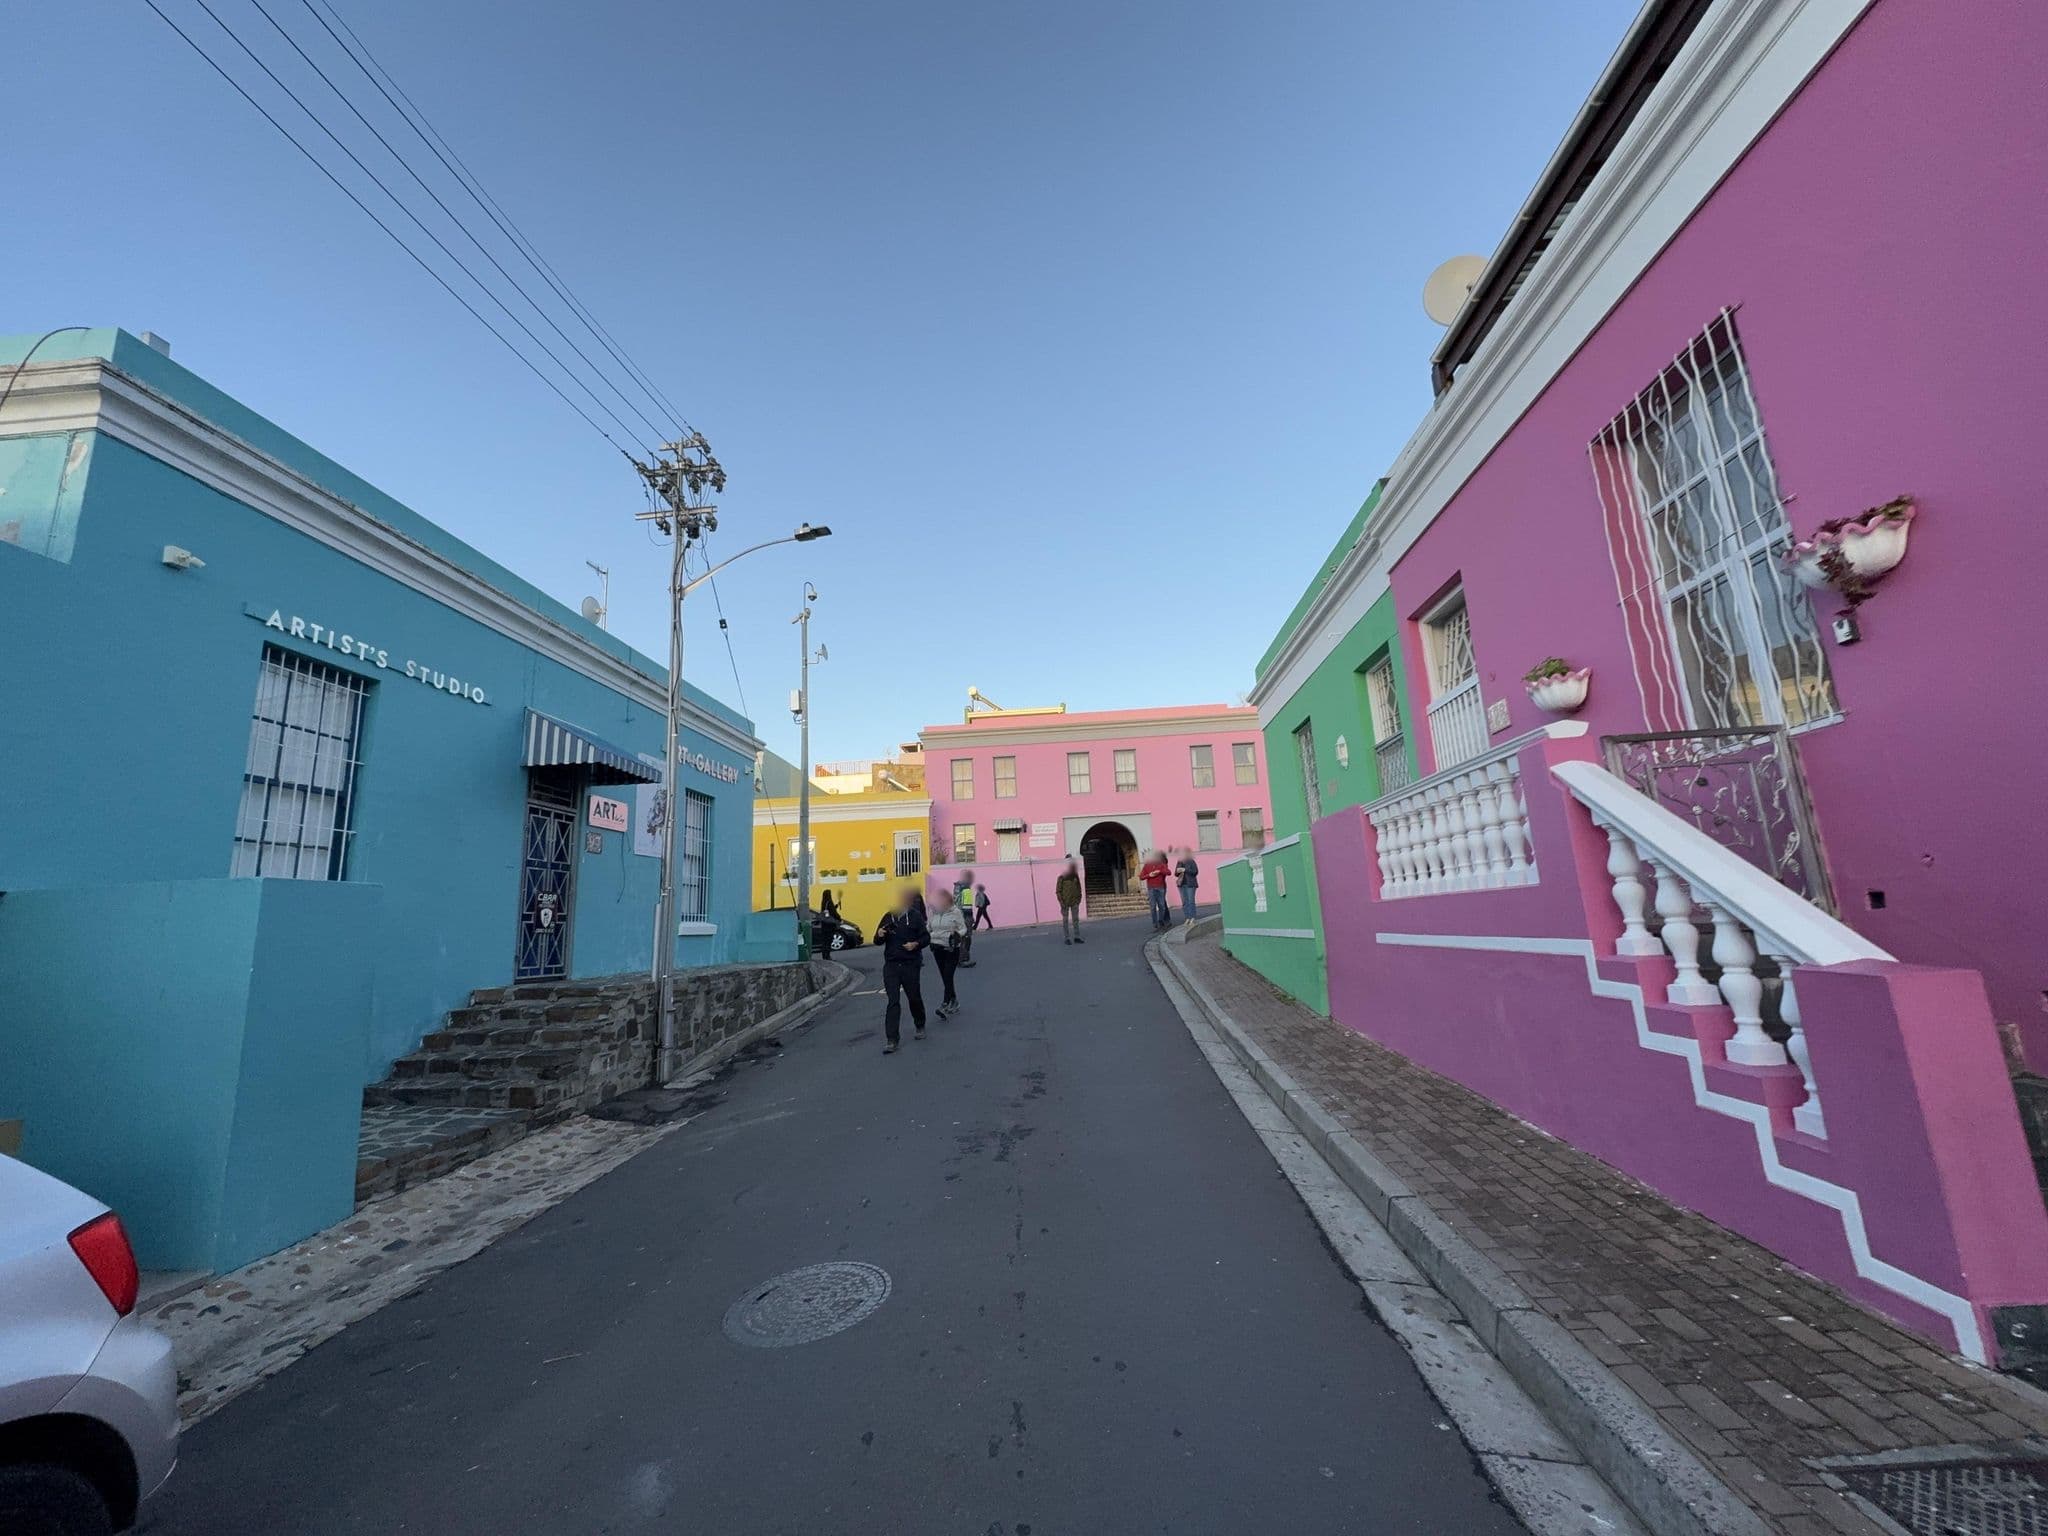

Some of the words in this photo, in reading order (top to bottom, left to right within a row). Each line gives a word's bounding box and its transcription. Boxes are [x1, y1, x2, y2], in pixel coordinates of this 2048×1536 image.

[265, 609, 388, 668] ARTIST'S
[406, 660, 484, 704] STUDIO
[696, 753, 739, 785] GALLERY
[593, 799, 618, 821] ART
